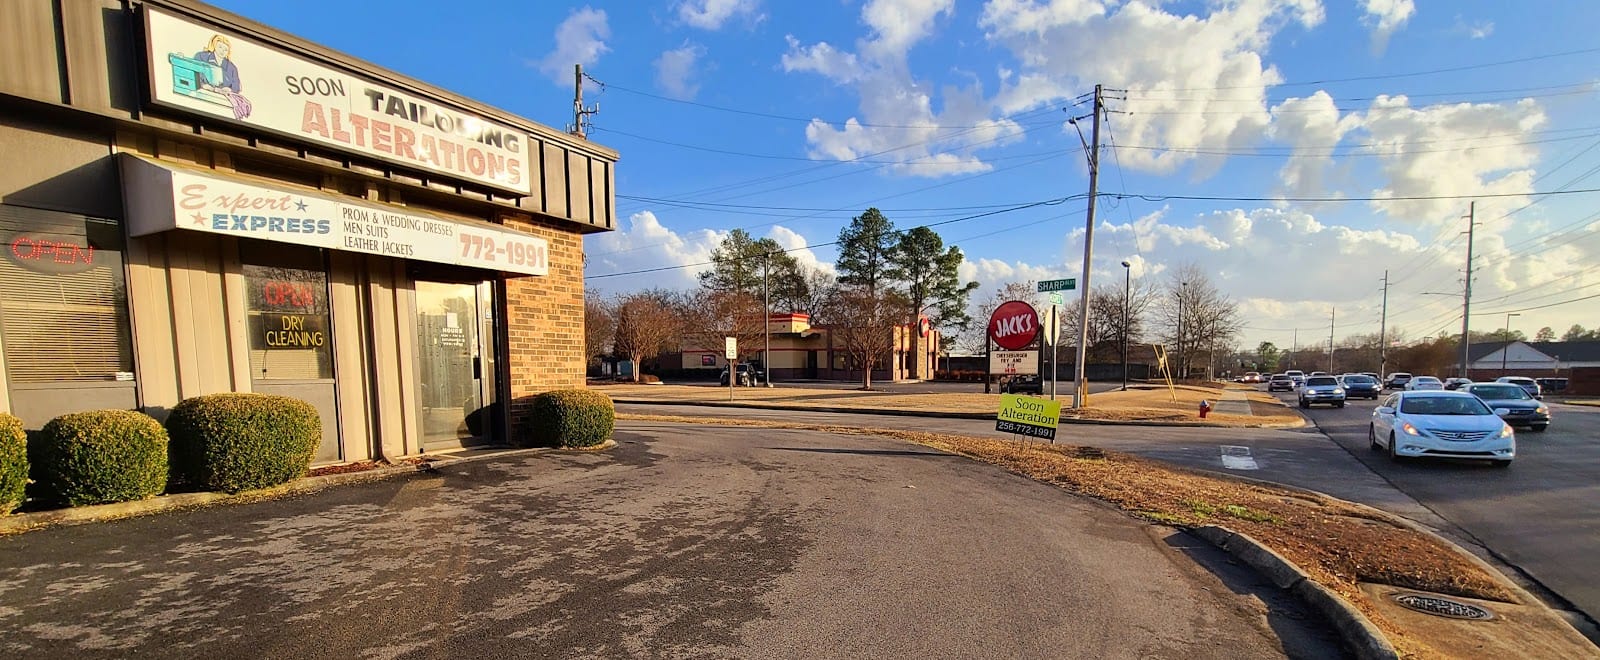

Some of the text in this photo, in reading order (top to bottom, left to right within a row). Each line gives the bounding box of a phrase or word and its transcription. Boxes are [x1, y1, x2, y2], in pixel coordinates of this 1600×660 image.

[286, 75, 345, 97] SOON
[364, 88, 520, 153] TAILOING
[302, 100, 521, 185] ALTERATIONS
[179, 183, 291, 215] Expert
[212, 213, 331, 235] EXPRESS
[342, 207, 453, 236] PROM & WEDDING DRESSES
[343, 222, 389, 239] MEN SUITS
[11, 237, 94, 265] OPEN
[344, 236, 413, 256] LEATHER JACKETS
[459, 233, 545, 269] 772-1991
[265, 281, 314, 307] OPEN
[1038, 281, 1065, 291] SHARP
[282, 315, 305, 331] DRY
[995, 313, 1032, 338] JACK'S
[266, 331, 323, 347] CLEANING
[1001, 407, 1055, 425] Alteration
[1015, 397, 1044, 413] Soon
[998, 421, 1053, 438] 256-772-1991
